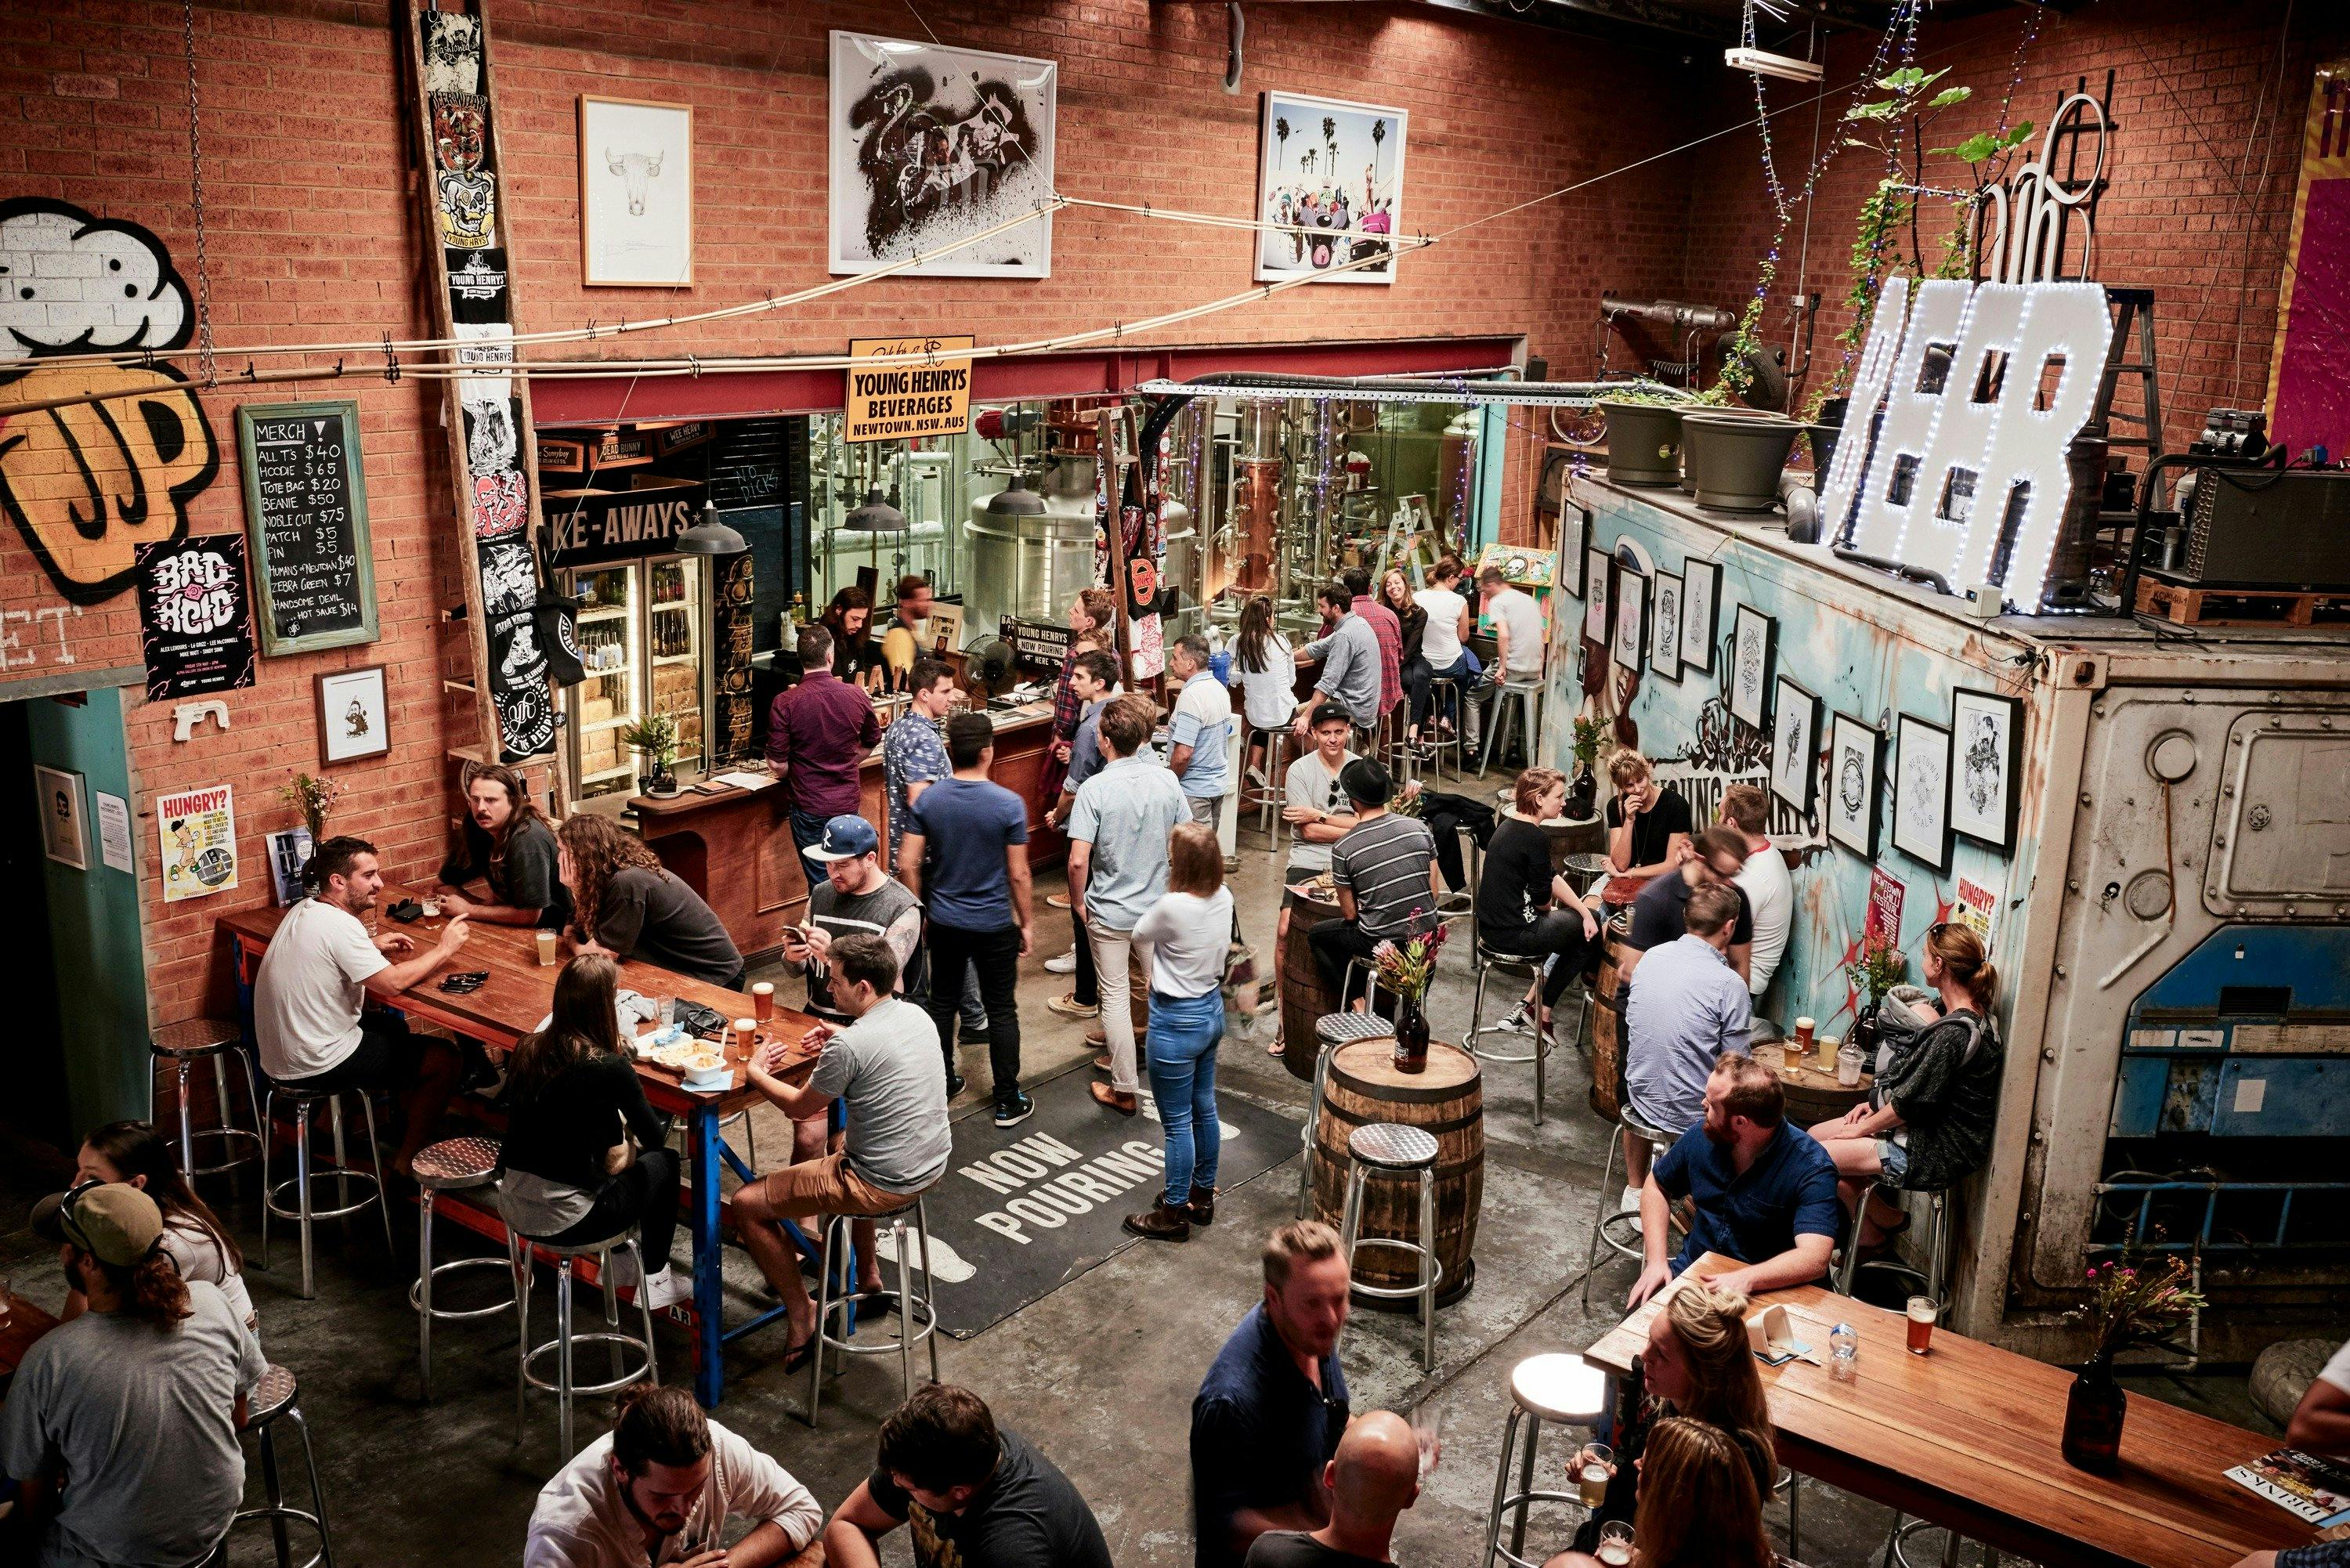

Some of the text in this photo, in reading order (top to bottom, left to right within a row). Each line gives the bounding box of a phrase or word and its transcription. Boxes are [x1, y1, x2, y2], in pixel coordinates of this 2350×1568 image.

[448, 235, 468, 247] YOUNG
[451, 273, 504, 286] YOUNG HENRYS
[462, 352, 512, 363] YOUNG HENRYS
[855, 368, 967, 397] YOUNG HENRYS
[868, 395, 953, 419] BEVERAGES
[256, 423, 306, 440] MERCH
[670, 428, 682, 441] WEE
[682, 423, 700, 435] HEAVY
[258, 450, 278, 463] ALL
[305, 444, 341, 461] $40
[543, 447, 569, 459] Sunnyboy
[602, 442, 641, 456] DEAD BUNNY
[1818, 276, 2115, 615] BEER
[259, 462, 336, 478] HOODIE $65
[736, 466, 757, 485] NO
[261, 478, 341, 494] TOTE BAG $20
[261, 494, 334, 511] BEANIE $50
[263, 507, 345, 529] NOBLE CUT $75
[551, 500, 689, 551] KE-AWAYS
[266, 526, 337, 545] PATCH $5
[266, 540, 338, 560] PIN $5
[268, 565, 298, 577] HUMANS
[306, 559, 338, 574] NEWTOWN
[338, 555, 356, 572] $40
[271, 573, 352, 594] ZEBRA GREEN $7
[273, 594, 344, 611] HANDSOME DEVIL
[316, 607, 338, 616] SAUCE
[340, 602, 358, 617] $14
[1018, 626, 1068, 643] YOUNG HENRYS
[1021, 641, 1063, 656] NOW POURING
[524, 658, 548, 681] SLINGERS
[1035, 656, 1049, 666] HERE
[1908, 754, 1940, 782] NEWTOWN
[163, 789, 227, 819] HUNGRY?
[1909, 806, 1934, 828] LOCALS
[1873, 872, 1902, 898] NEWTOWN
[1874, 893, 1900, 919] FESTIVAL
[1882, 889, 1900, 909] CHILLI
[1958, 877, 1994, 916] HUNGRY?
[956, 1131, 1084, 1195] NOW
[974, 1140, 1166, 1245] POURING
[2236, 1470, 2322, 1517] DRINKS
